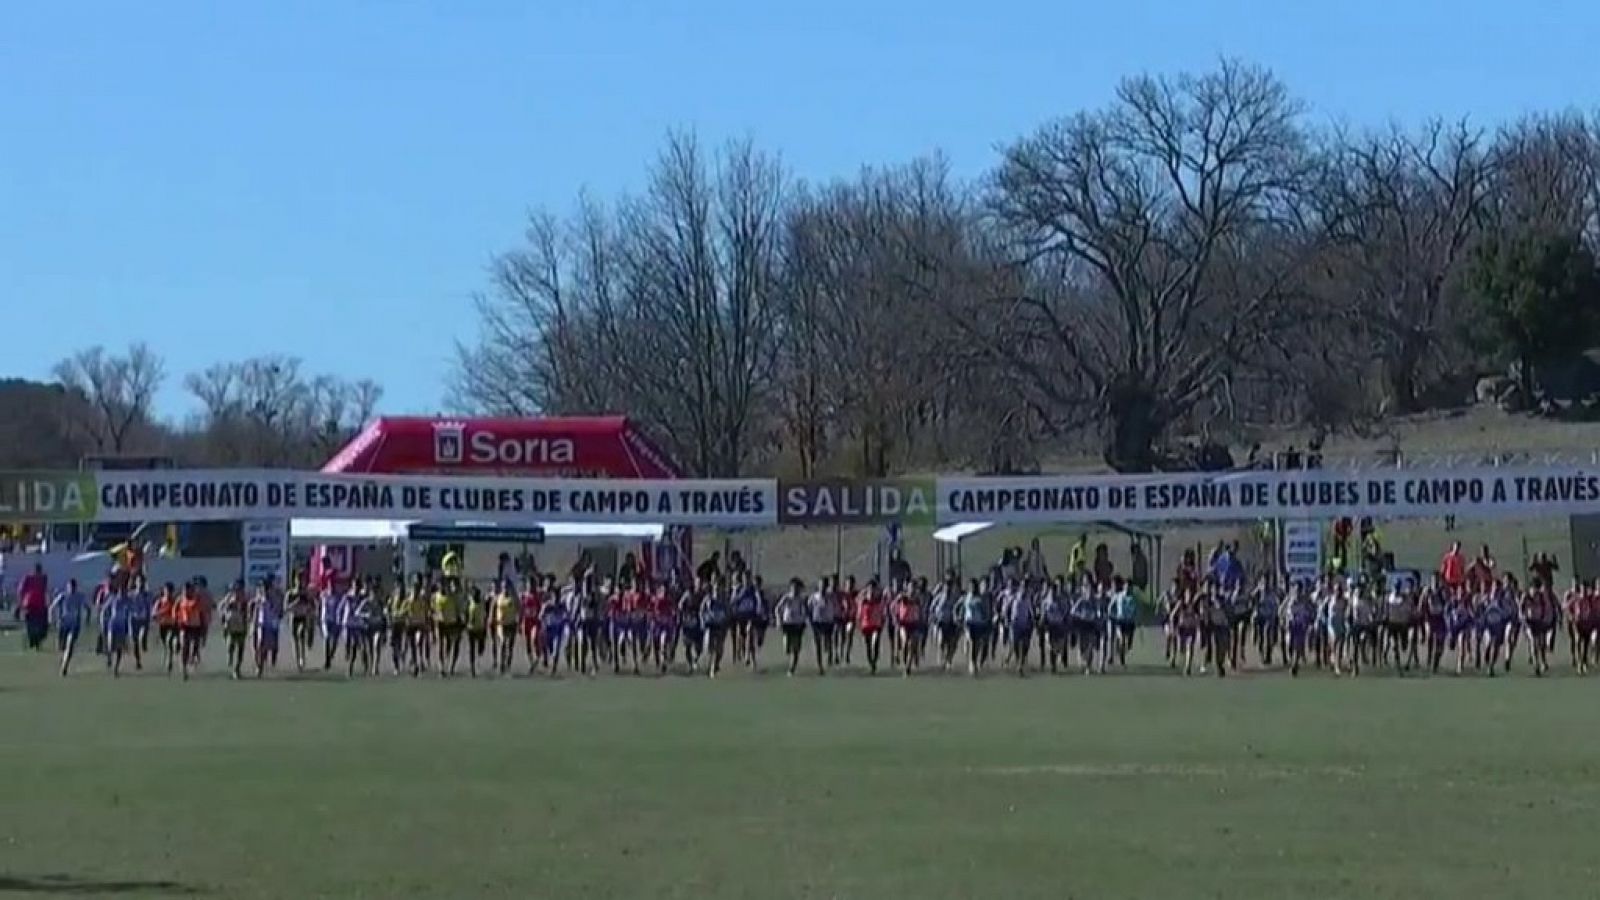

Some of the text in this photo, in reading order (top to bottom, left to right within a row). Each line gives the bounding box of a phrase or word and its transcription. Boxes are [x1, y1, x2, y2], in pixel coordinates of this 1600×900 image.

[470, 431, 574, 463] Soria
[101, 480, 765, 514] CAMPEONATO DE ESPAÑA DE CLUBES DE CAMPO A TRAVÉS
[787, 486, 930, 516] SALIDA
[950, 470, 1600, 513] CAMPEONATO DE ESPAÑA DE CLUBES DE CAMPO A TRAVÉS
